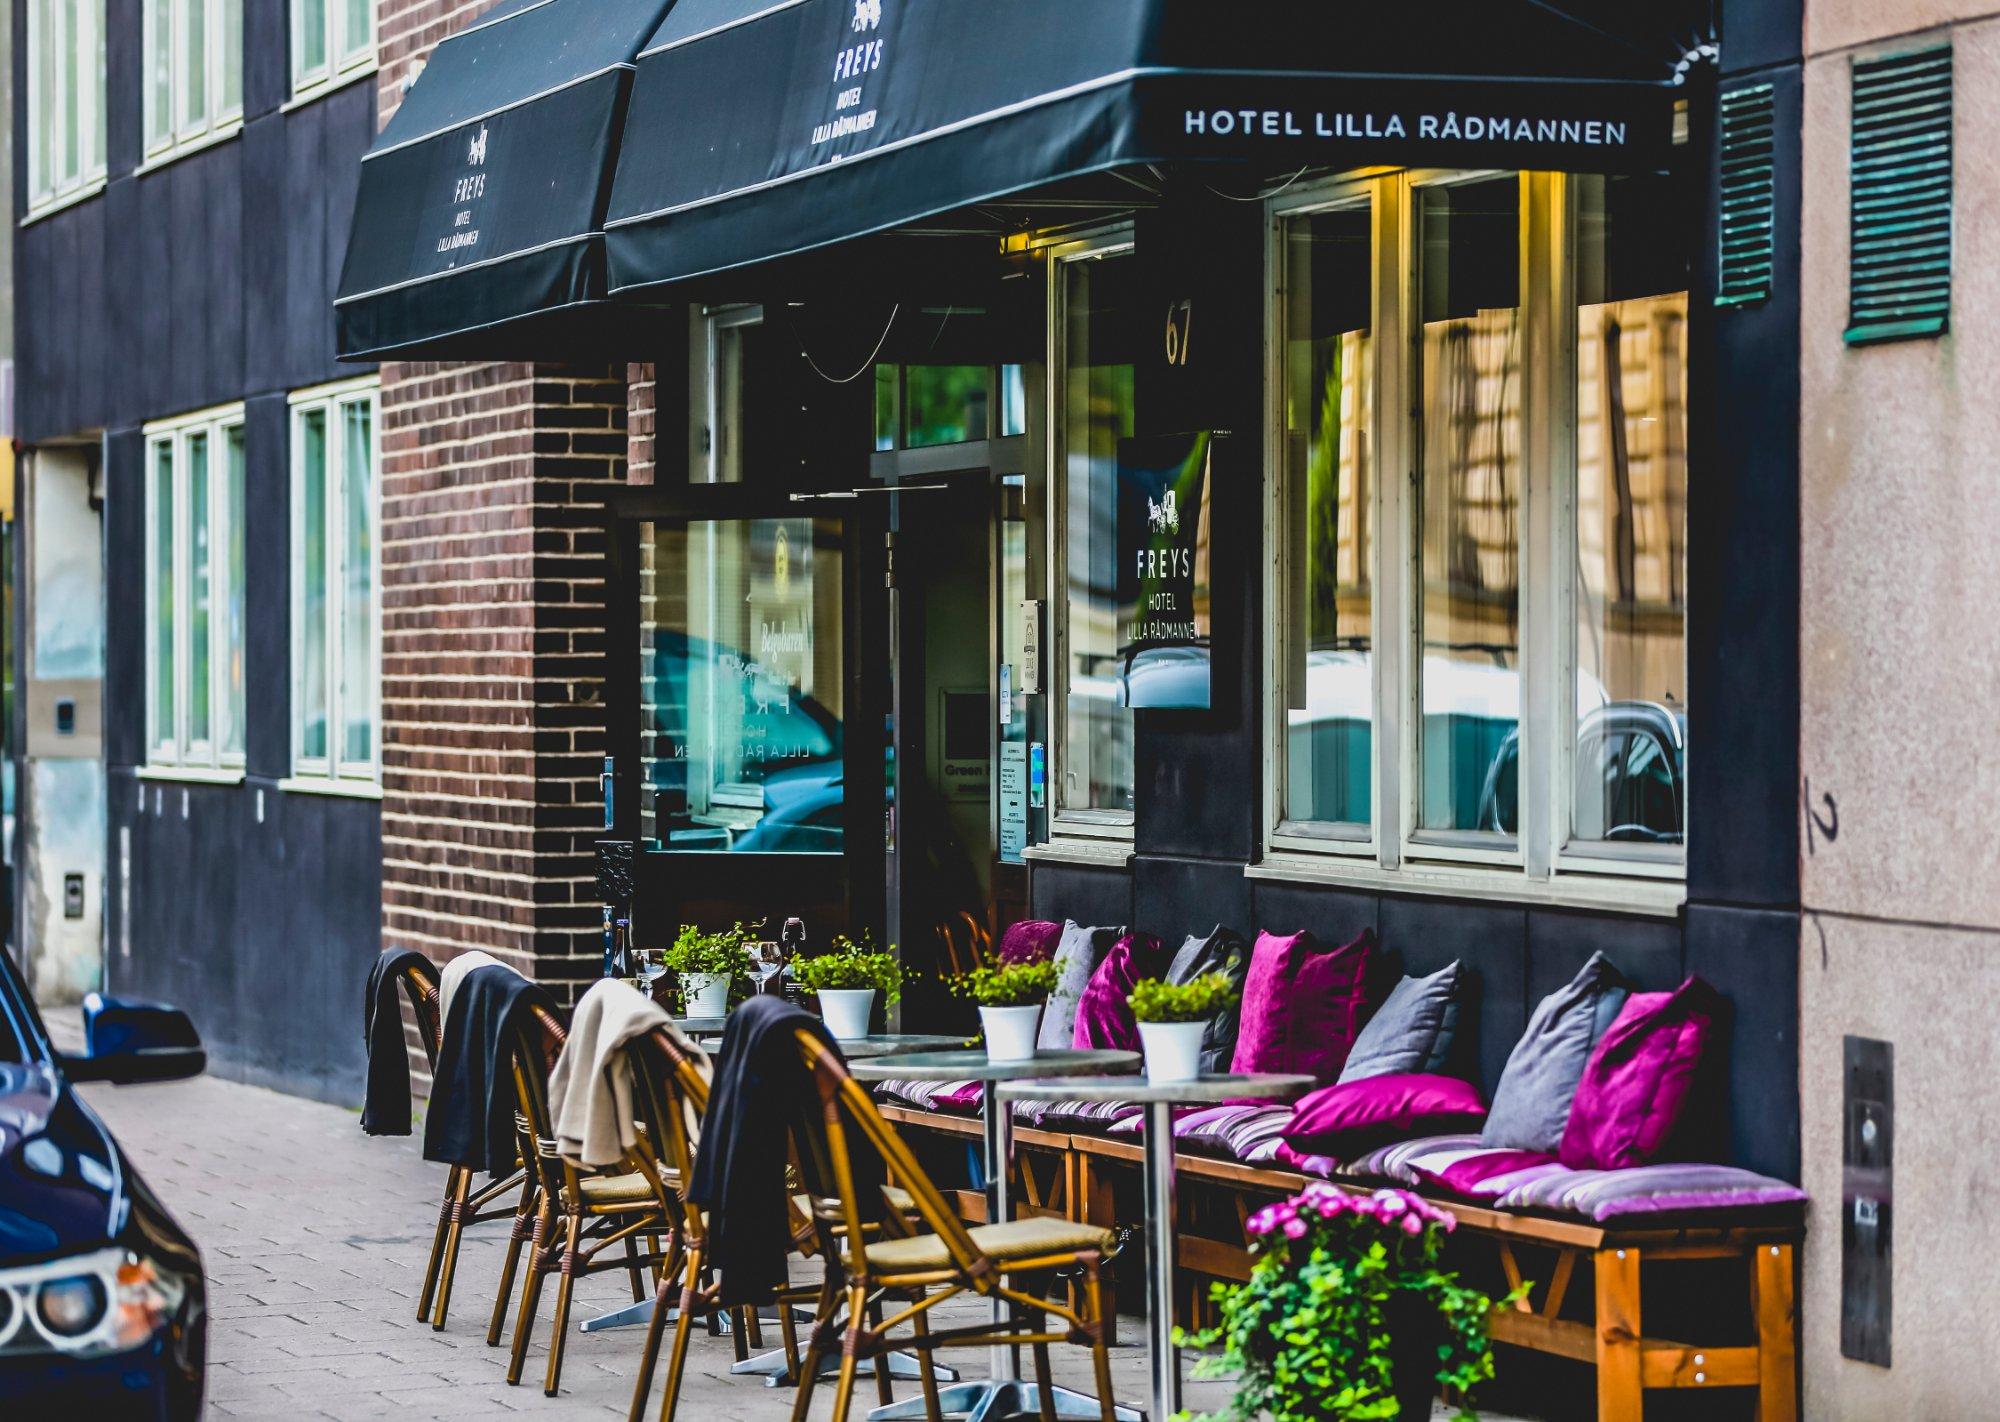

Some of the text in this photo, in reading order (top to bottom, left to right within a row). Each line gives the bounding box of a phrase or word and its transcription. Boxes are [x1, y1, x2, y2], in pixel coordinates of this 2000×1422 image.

[833, 38, 884, 83] FREYS
[836, 86, 862, 111] HOTEL
[811, 122, 832, 145] LILLA
[1185, 110, 1626, 145] HOTEL LILLA RÅDMANNEN
[453, 173, 486, 204] FREYS
[454, 210, 471, 227] HOTEL
[1166, 299, 1192, 366] 67
[1137, 547, 1190, 579] FREYS
[1148, 592, 1177, 611] HOTEL
[1126, 618, 1201, 640] LILLA RÅDMANNEN
[944, 764, 983, 777] Green
